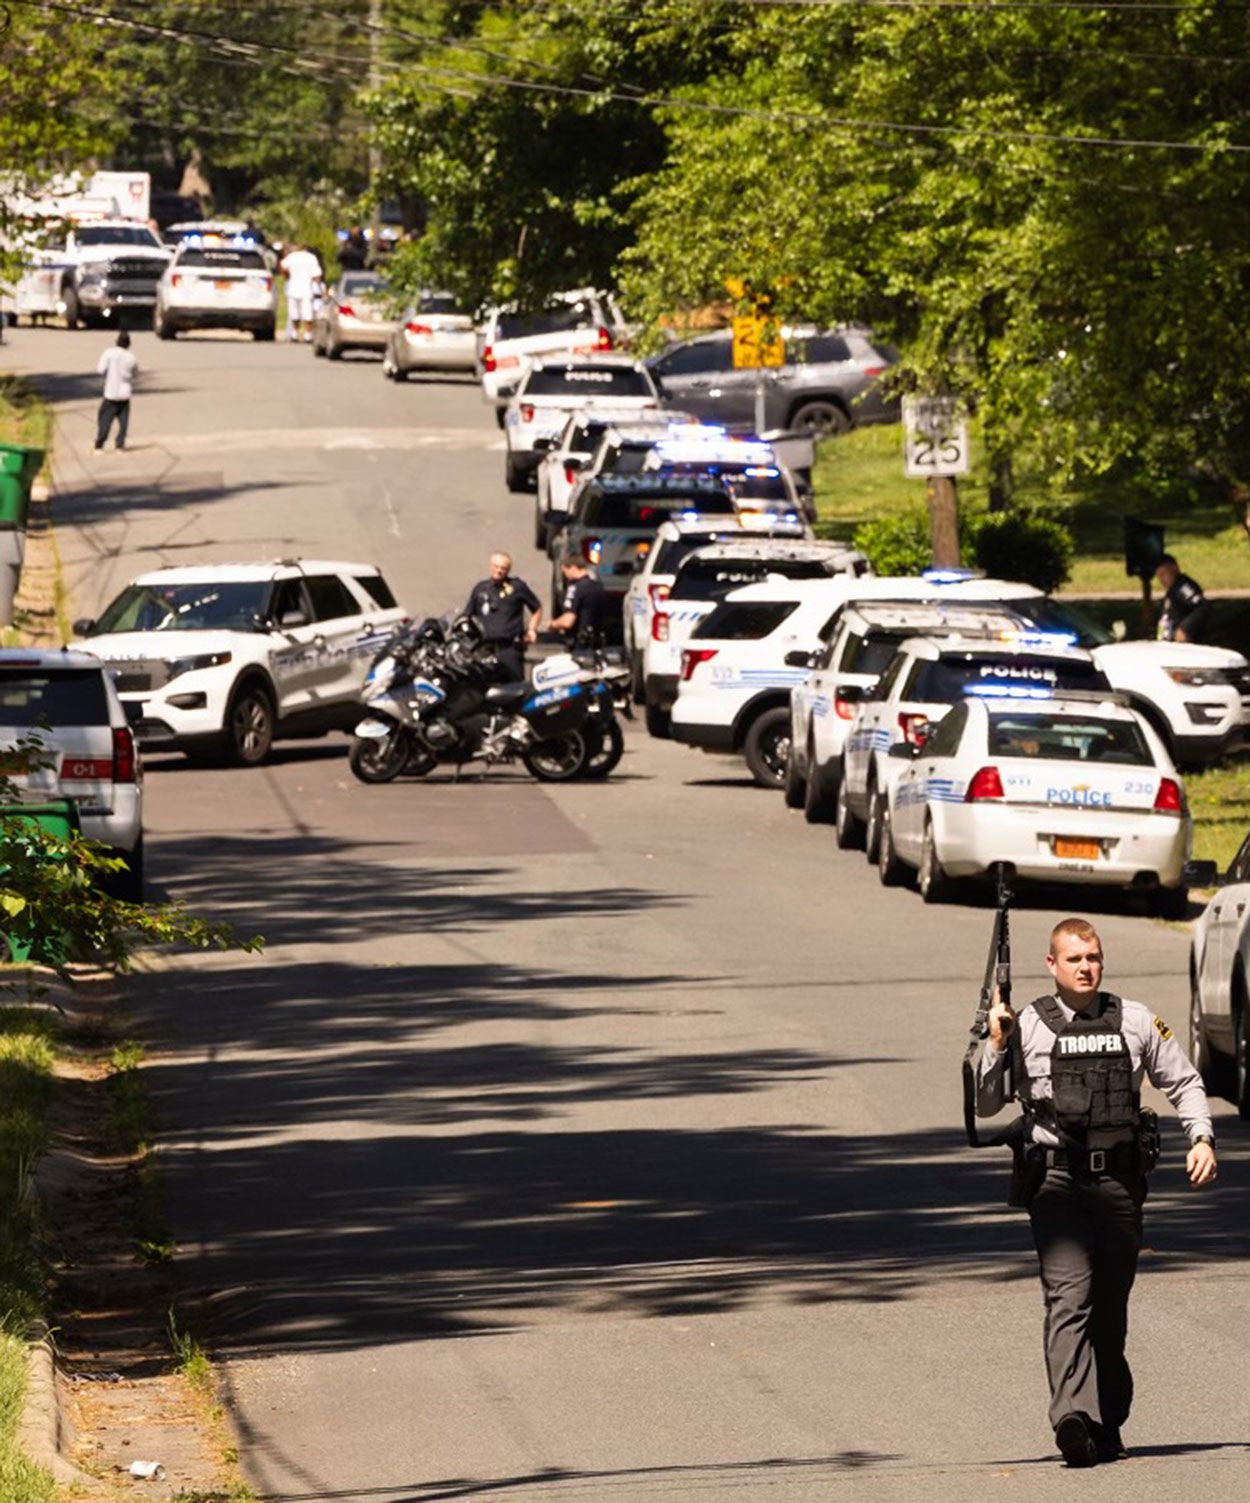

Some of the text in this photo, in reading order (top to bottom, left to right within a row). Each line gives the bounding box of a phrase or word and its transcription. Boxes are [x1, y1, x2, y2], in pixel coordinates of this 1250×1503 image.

[914, 436, 960, 465] 25
[980, 666, 1057, 681] POLICE
[1047, 787, 1112, 806] POLICE
[1124, 780, 1153, 795] 230
[1058, 1034, 1122, 1054] TROOPER
